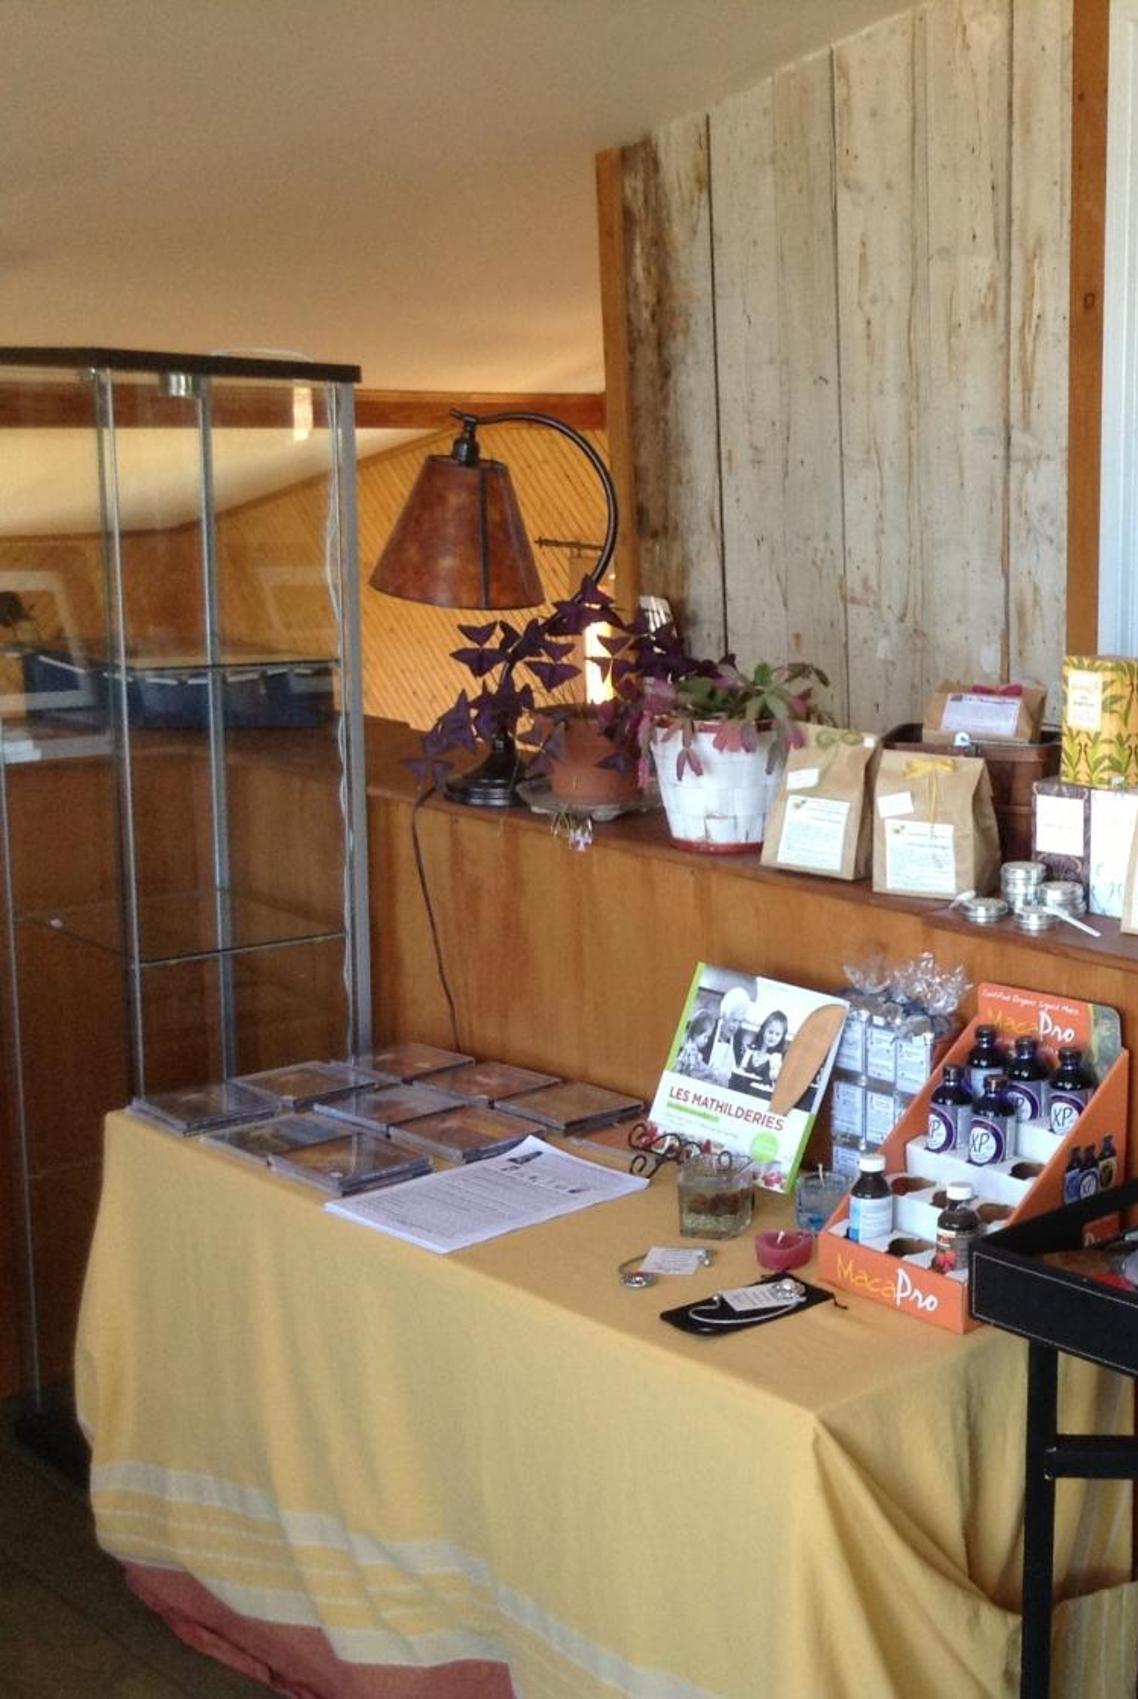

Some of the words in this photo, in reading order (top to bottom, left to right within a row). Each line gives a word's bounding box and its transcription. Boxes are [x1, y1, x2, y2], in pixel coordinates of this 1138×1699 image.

[669, 1086, 690, 1102] LES
[691, 1092, 785, 1132] MATHILDERIES
[1053, 1106, 1073, 1127] XP
[970, 1132, 990, 1153] XP
